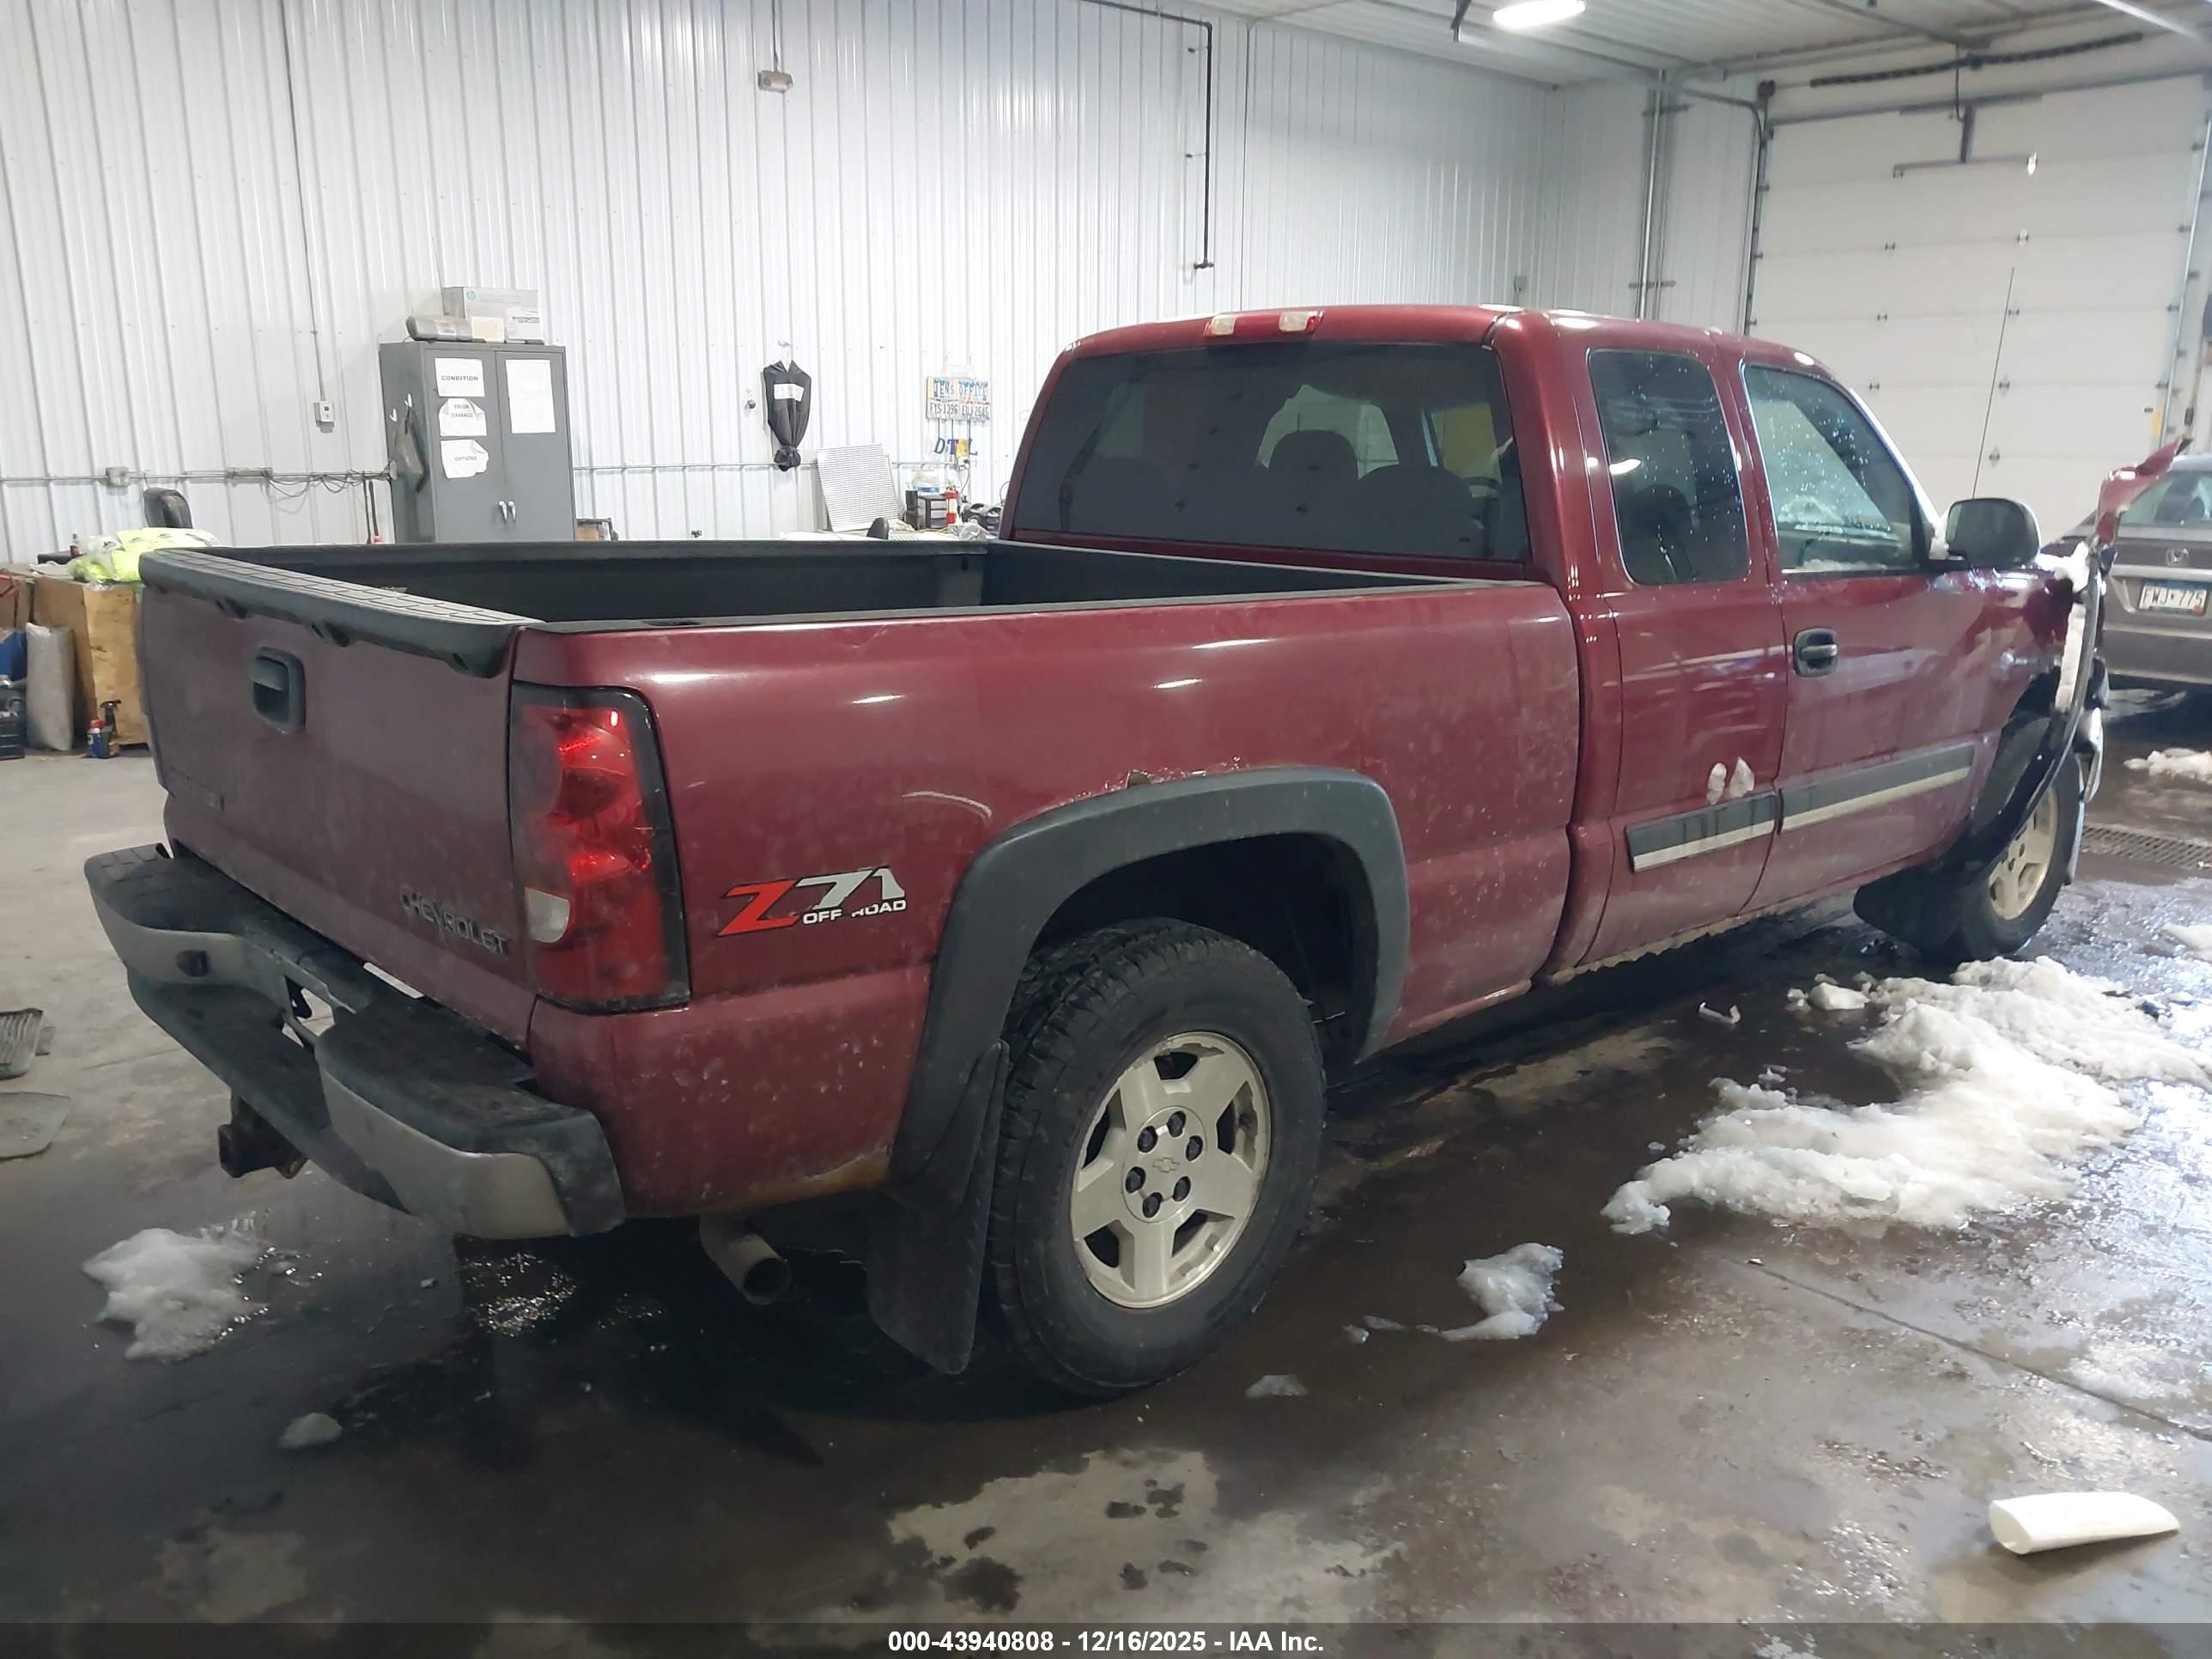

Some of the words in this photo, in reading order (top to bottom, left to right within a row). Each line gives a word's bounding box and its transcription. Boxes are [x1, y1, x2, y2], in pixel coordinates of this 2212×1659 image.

[400, 884, 508, 957] CHEVROLET
[717, 866, 906, 937] Z71
[802, 908, 842, 925] OFF
